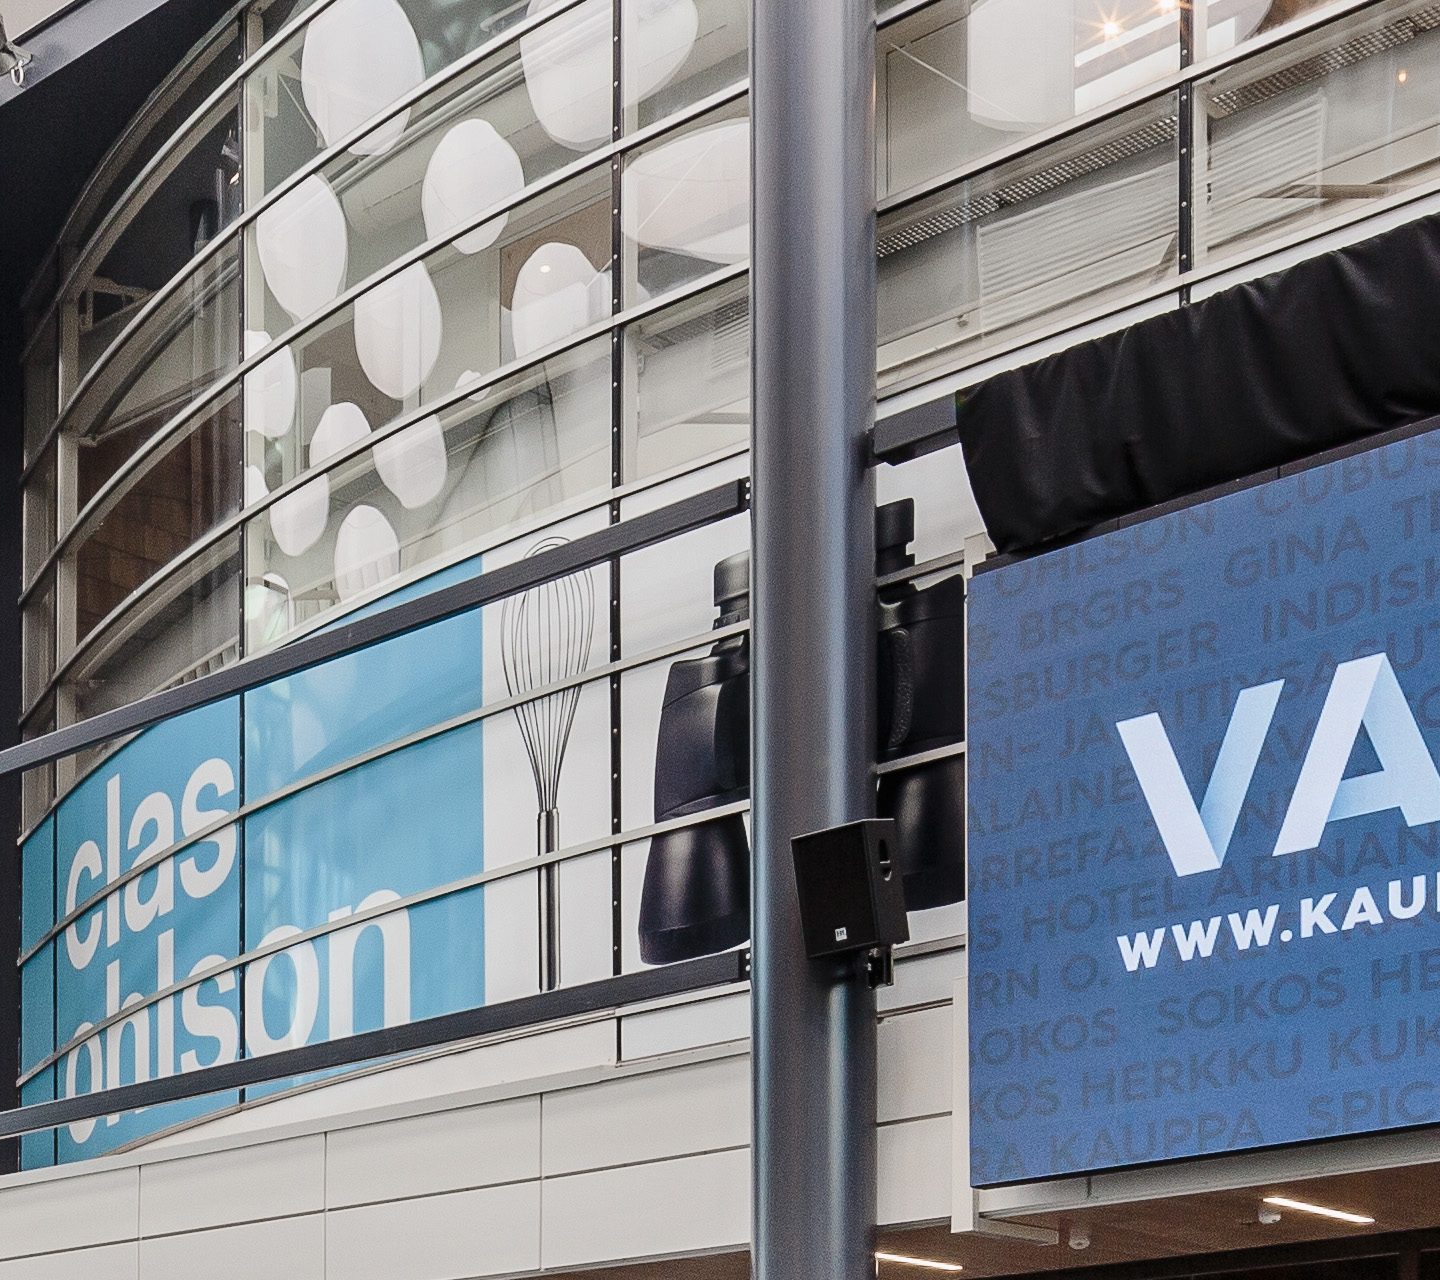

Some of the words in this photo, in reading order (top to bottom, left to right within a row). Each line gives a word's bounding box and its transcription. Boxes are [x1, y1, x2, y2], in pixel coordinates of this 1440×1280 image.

[1019, 564, 1184, 651] BRGRS
[1224, 509, 1369, 593] GINA
[65, 756, 238, 971] clas
[1022, 870, 1187, 943] HOTEL
[1209, 817, 1438, 906] ARINAN
[1157, 964, 1346, 1037] SOKOS
[1081, 1035, 1302, 1109] HERKKU
[1049, 1103, 1264, 1172] KAUPPA
